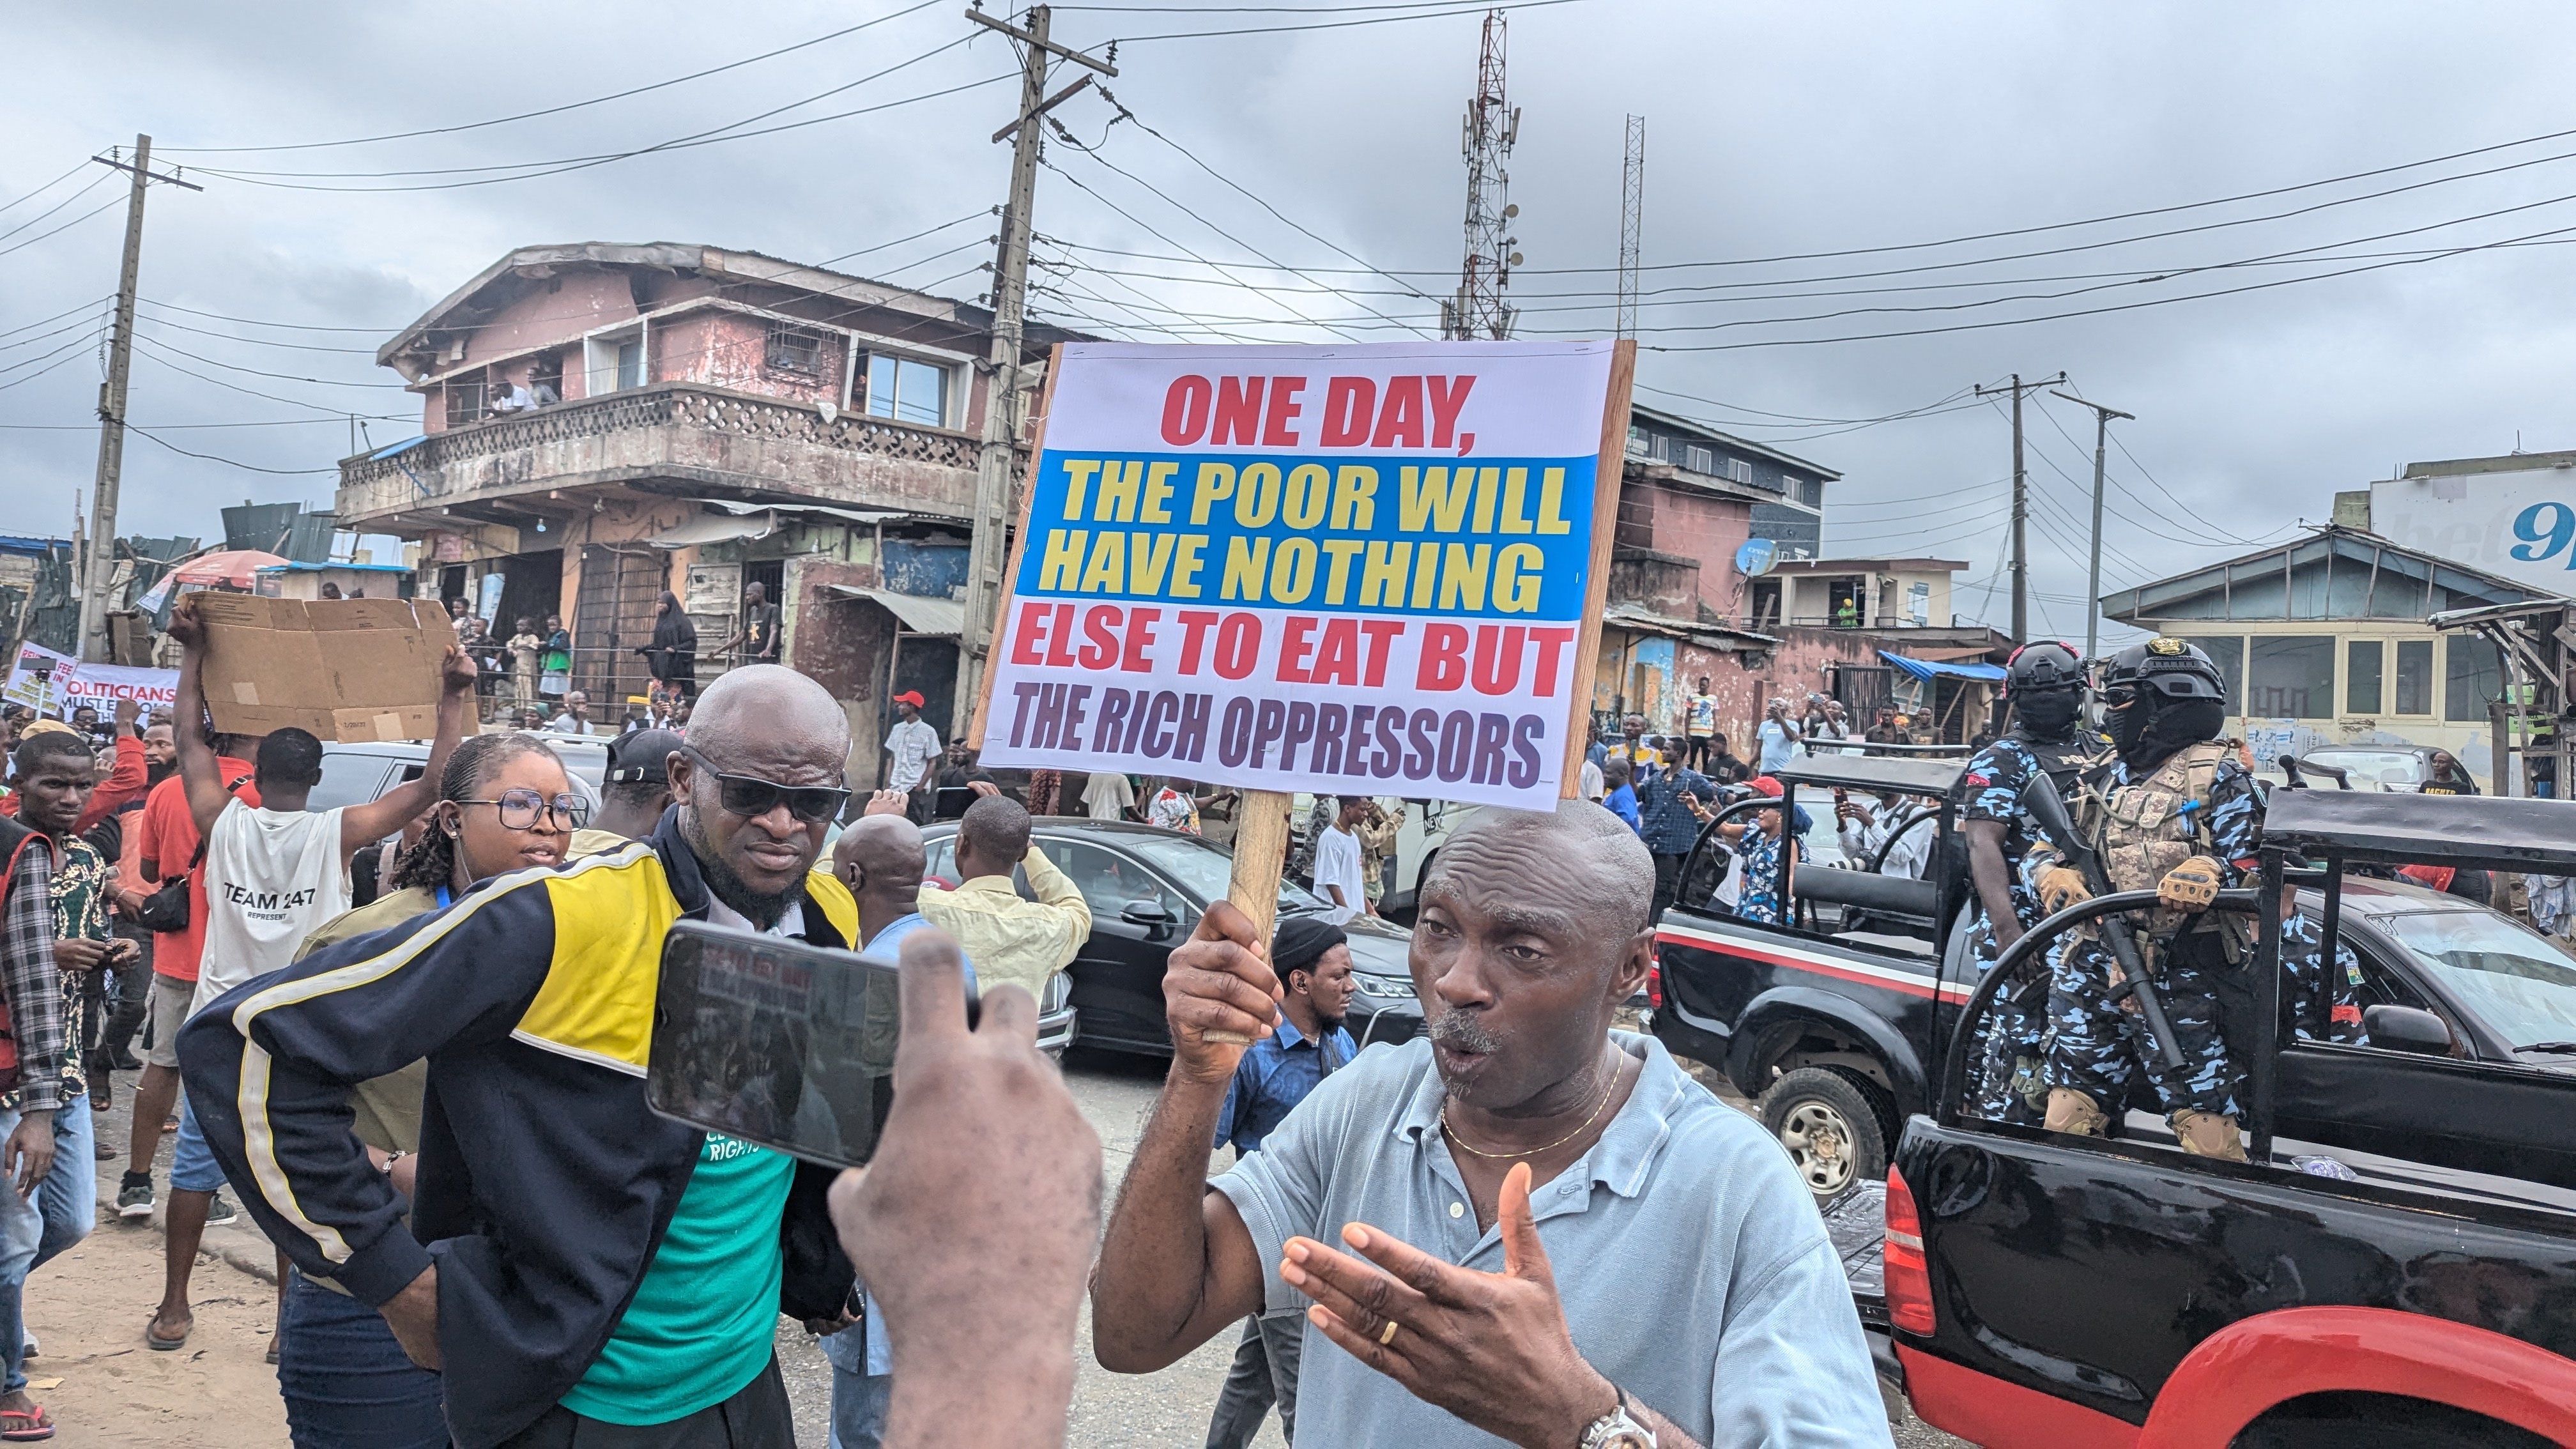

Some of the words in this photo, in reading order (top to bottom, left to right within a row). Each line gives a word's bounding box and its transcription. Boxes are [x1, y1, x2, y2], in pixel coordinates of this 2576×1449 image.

[1161, 375, 1307, 447] ONE
[1321, 376, 1475, 456] DAY,
[1062, 459, 1179, 523] THE
[1190, 463, 1378, 529] POOR
[1399, 466, 1570, 534] WILL
[1039, 529, 1204, 598] HAVE
[1220, 536, 1544, 613] NOTHING
[1011, 602, 1161, 673] ELSE
[1177, 611, 1262, 680] TO
[1276, 617, 1405, 687] EAT
[1416, 624, 1574, 697] BUT
[53, 673, 64, 683] IN
[57, 662, 73, 675] FEE
[62, 696, 102, 710] MUST
[66, 680, 176, 703] OLITICIANS
[1008, 682, 1092, 751] THE
[1091, 687, 1213, 763] RICH
[1218, 696, 1545, 790] OPPRESSORS
[2057, 755, 2089, 765] POL
[224, 882, 279, 910] TEAM
[283, 888, 316, 909] 247
[247, 911, 288, 921] REPRESENT
